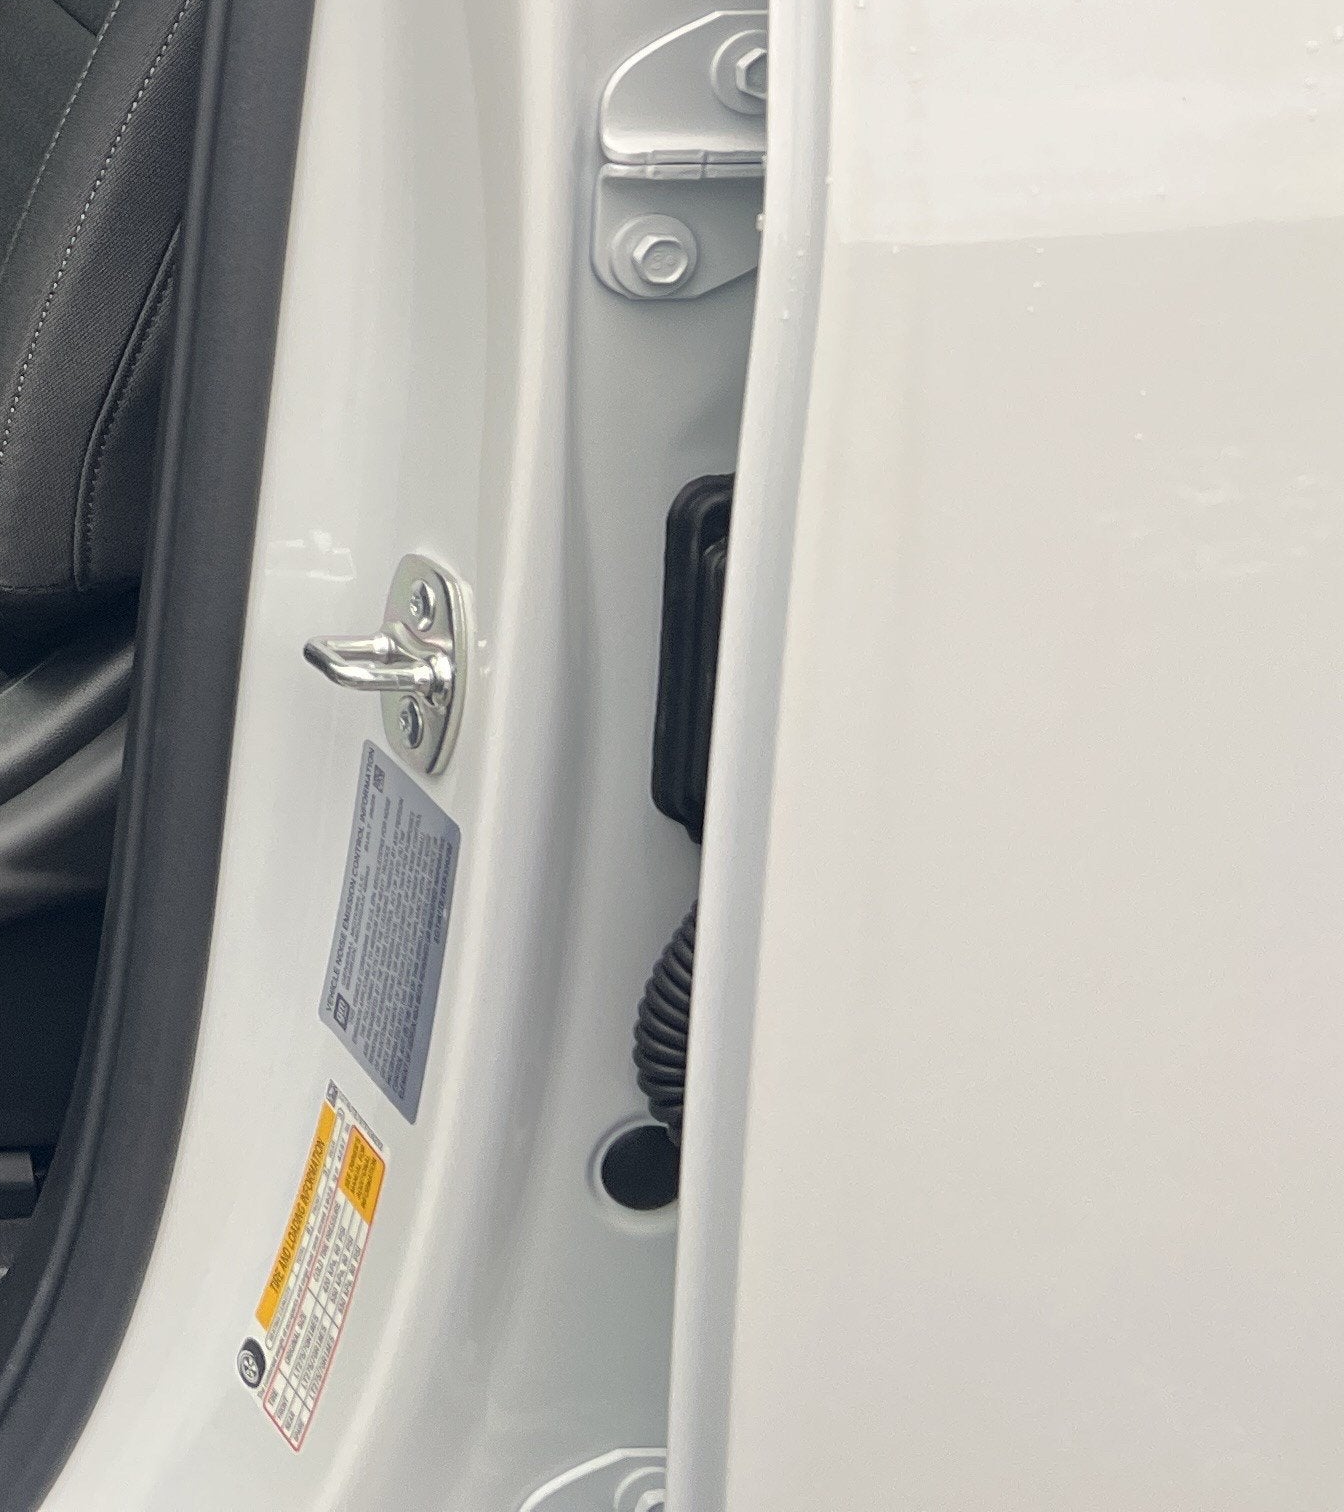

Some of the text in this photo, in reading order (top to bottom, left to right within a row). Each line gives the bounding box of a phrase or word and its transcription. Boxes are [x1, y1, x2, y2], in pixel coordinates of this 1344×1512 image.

[327, 966, 340, 1016] VEHICLE
[337, 931, 346, 967] NOISE
[343, 878, 356, 931] EMISSION
[352, 827, 364, 877] CONTROL
[360, 748, 375, 823] INFORMATION
[279, 1246, 292, 1272] AND
